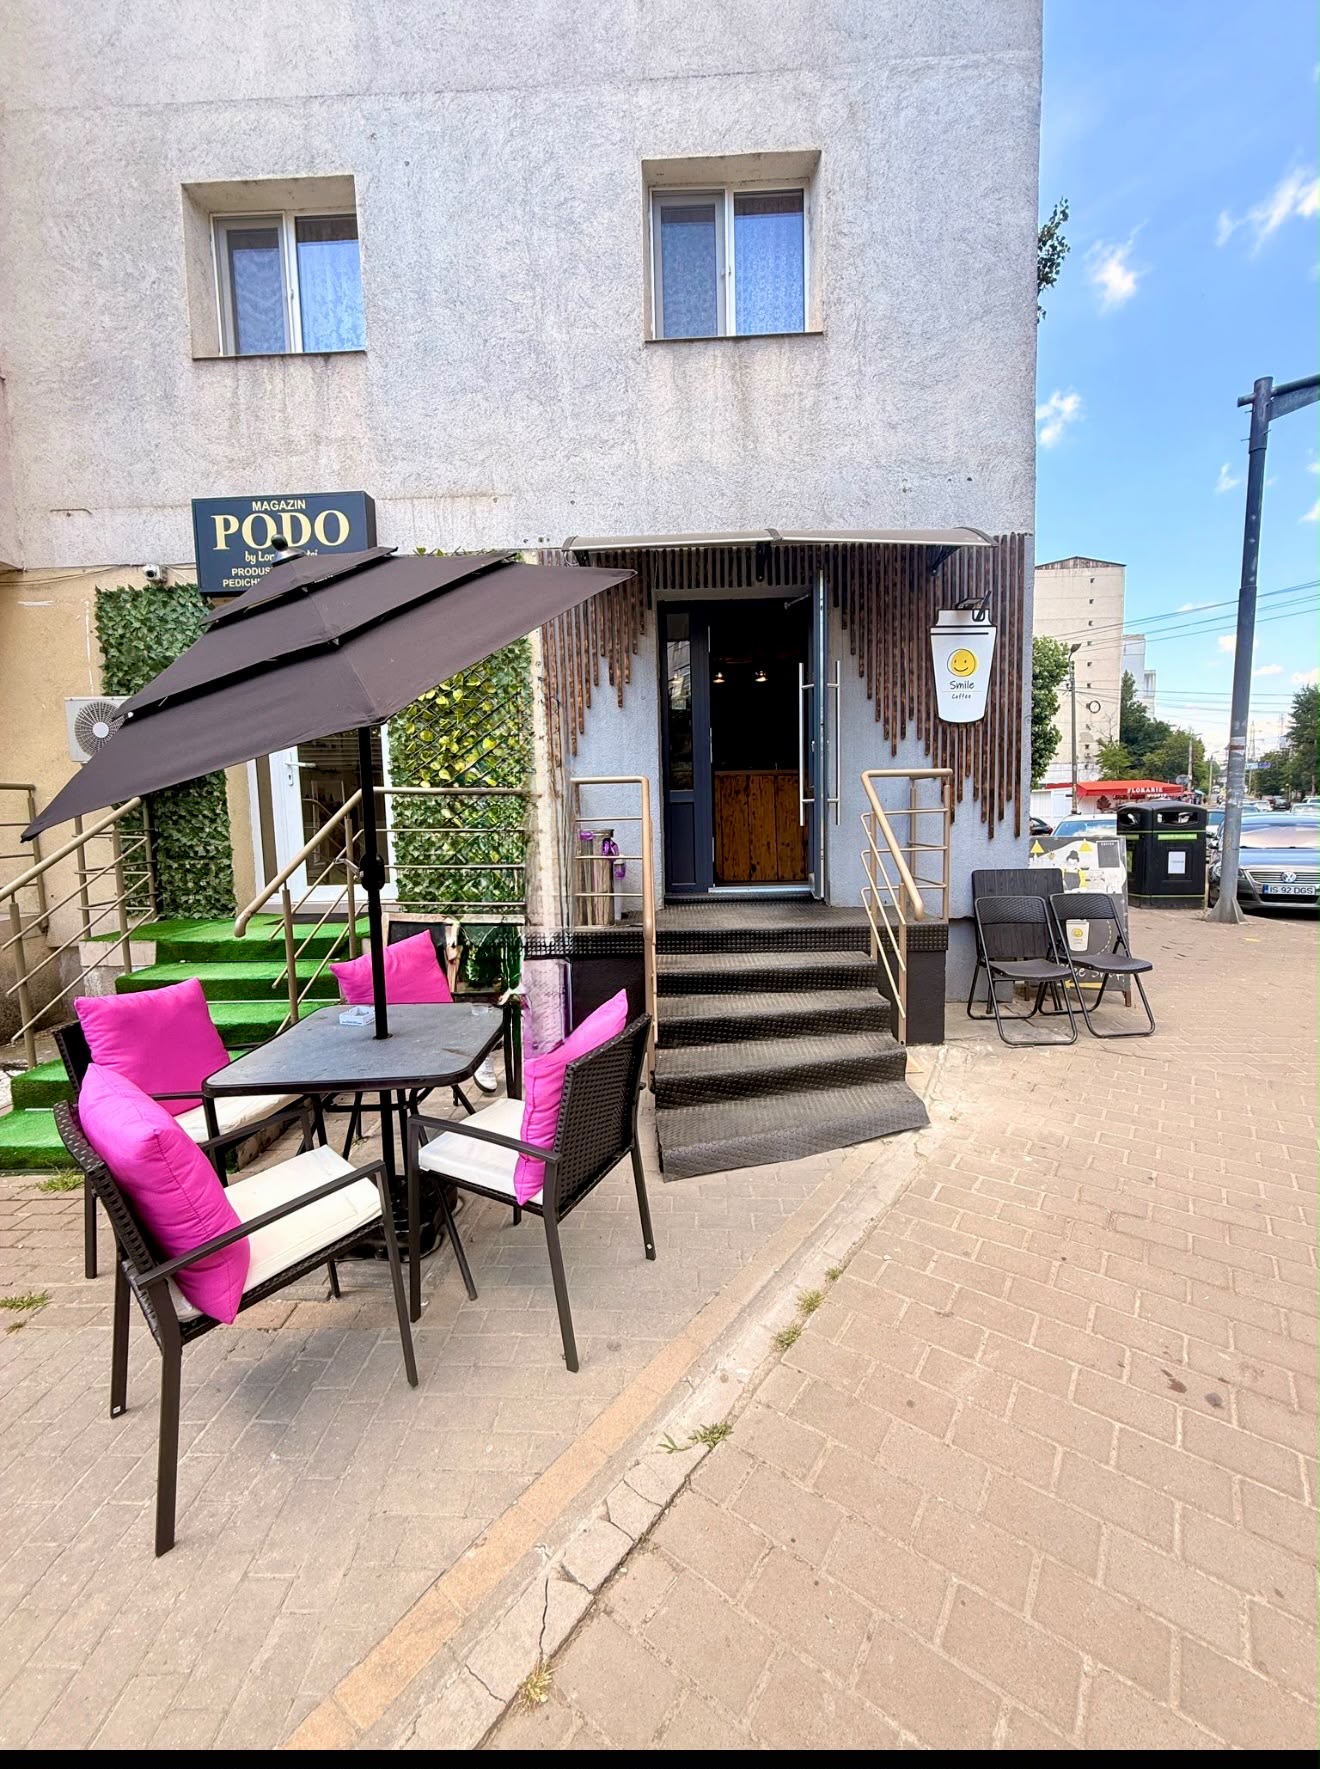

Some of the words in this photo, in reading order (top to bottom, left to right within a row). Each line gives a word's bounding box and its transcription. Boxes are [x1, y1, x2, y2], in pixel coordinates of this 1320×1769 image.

[252, 499, 306, 512] MAGAZIN
[210, 509, 350, 551] PODO
[245, 551, 257, 565] by
[259, 551, 275, 562] Lor
[231, 566, 272, 577] PRODUS
[222, 578, 260, 588] PEDICH
[949, 680, 975, 690] Smile
[1281, 886, 1292, 894] 92
